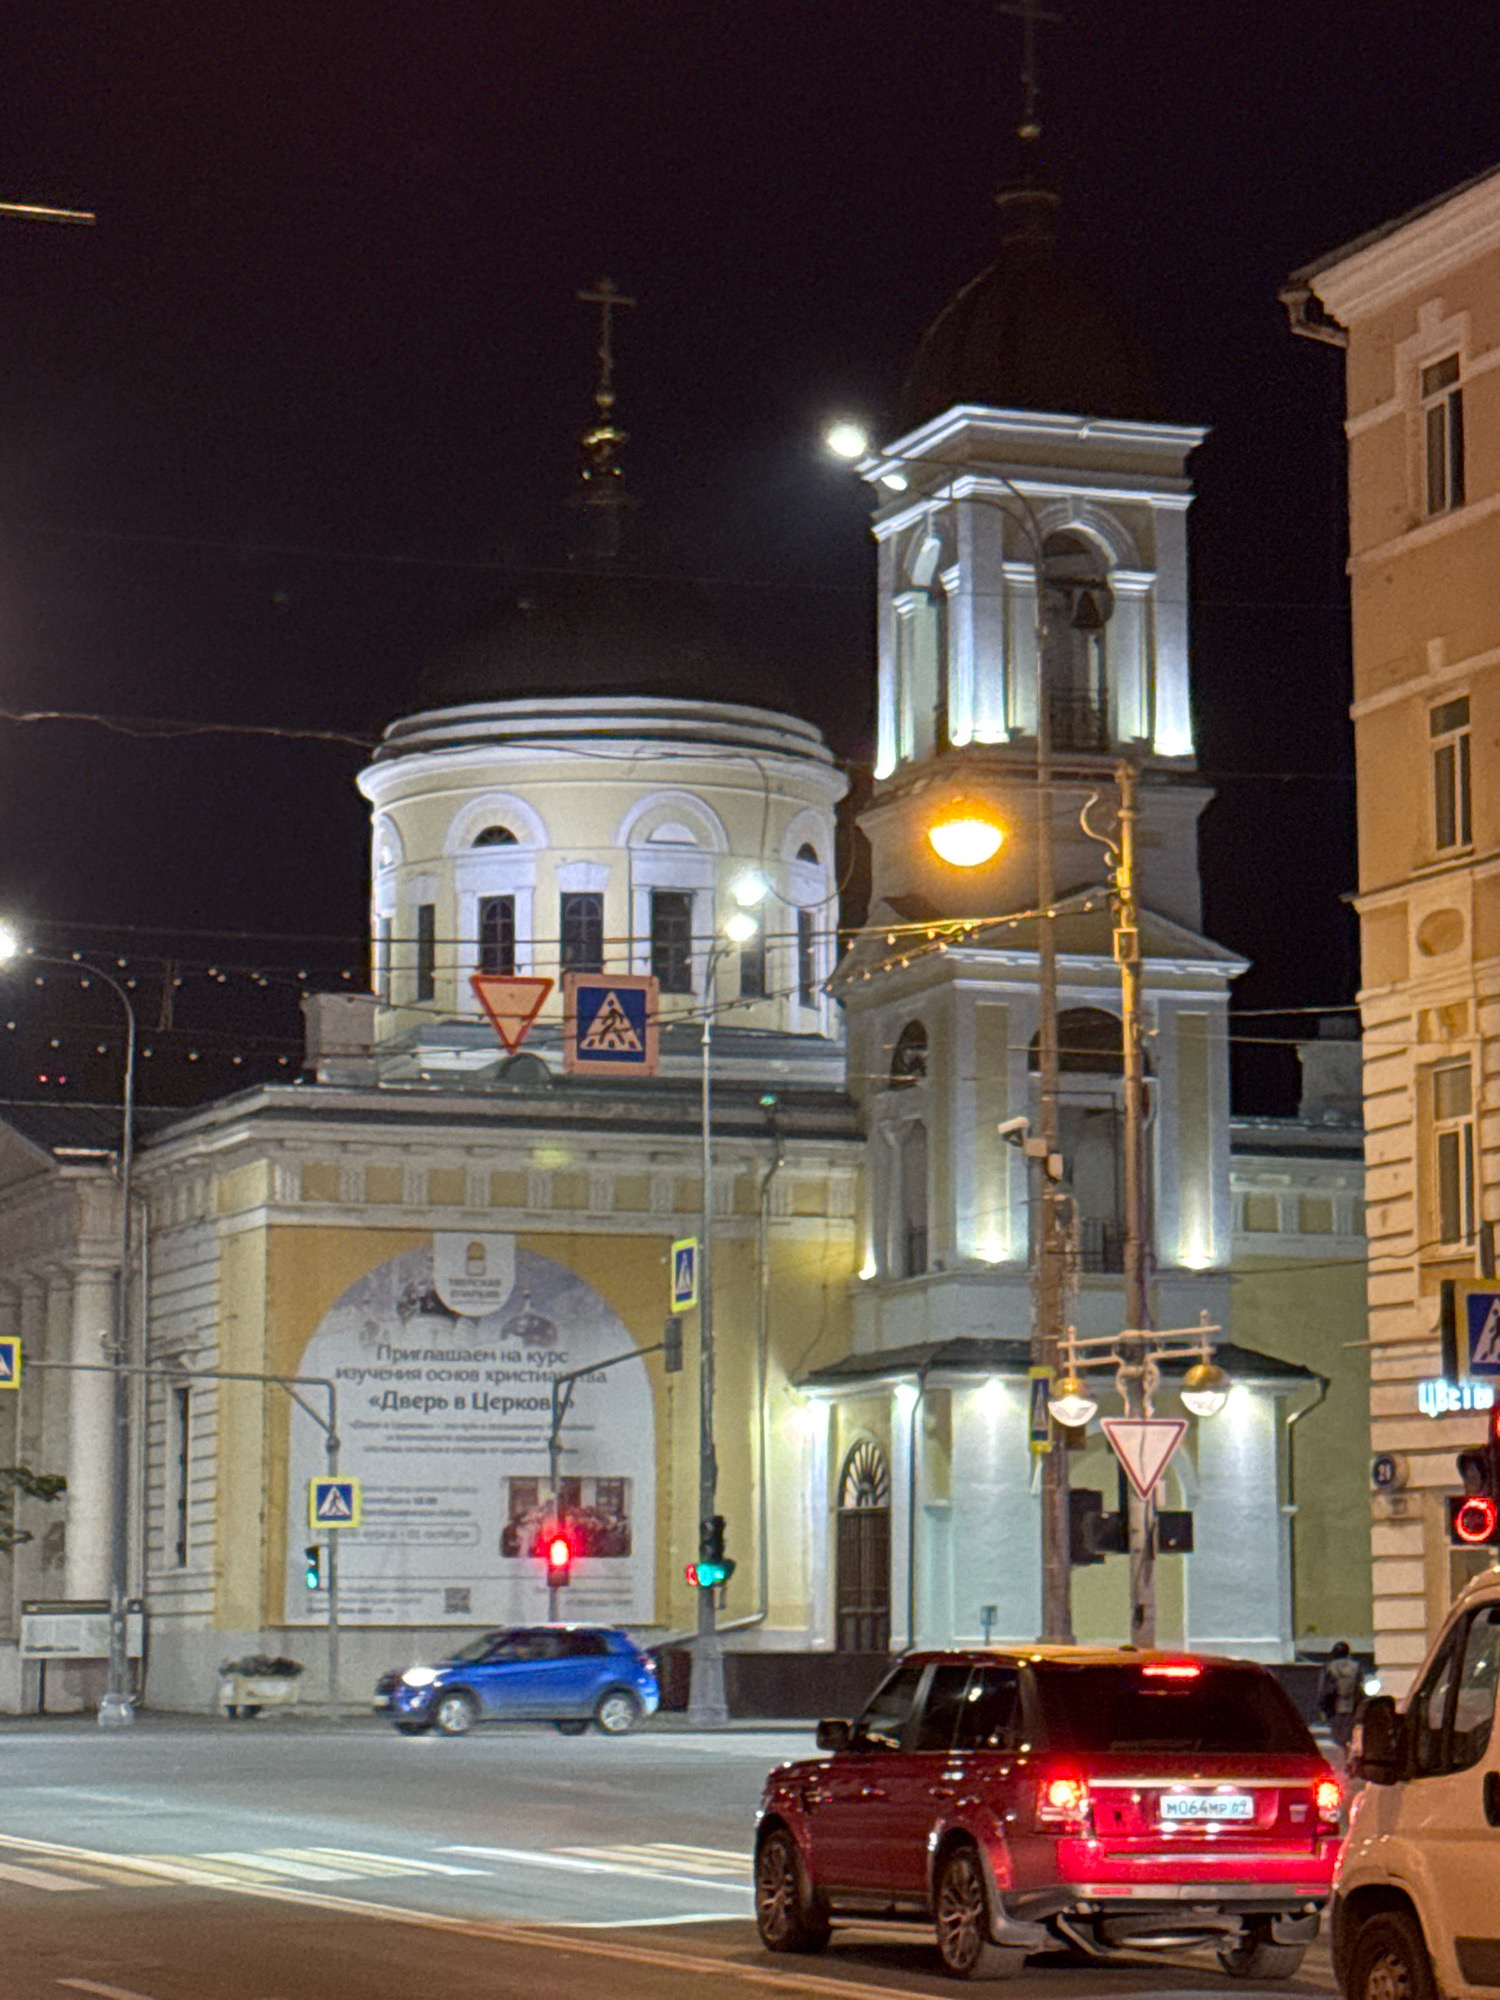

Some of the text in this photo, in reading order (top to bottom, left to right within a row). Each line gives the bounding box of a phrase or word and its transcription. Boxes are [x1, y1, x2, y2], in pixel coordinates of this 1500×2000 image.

[376, 1344, 569, 1367] Приглашаем на курс
[335, 1367, 422, 1384] изучения
[426, 1368, 480, 1382] основ
[369, 1391, 448, 1414] «Дверь
[453, 1396, 466, 1410] в
